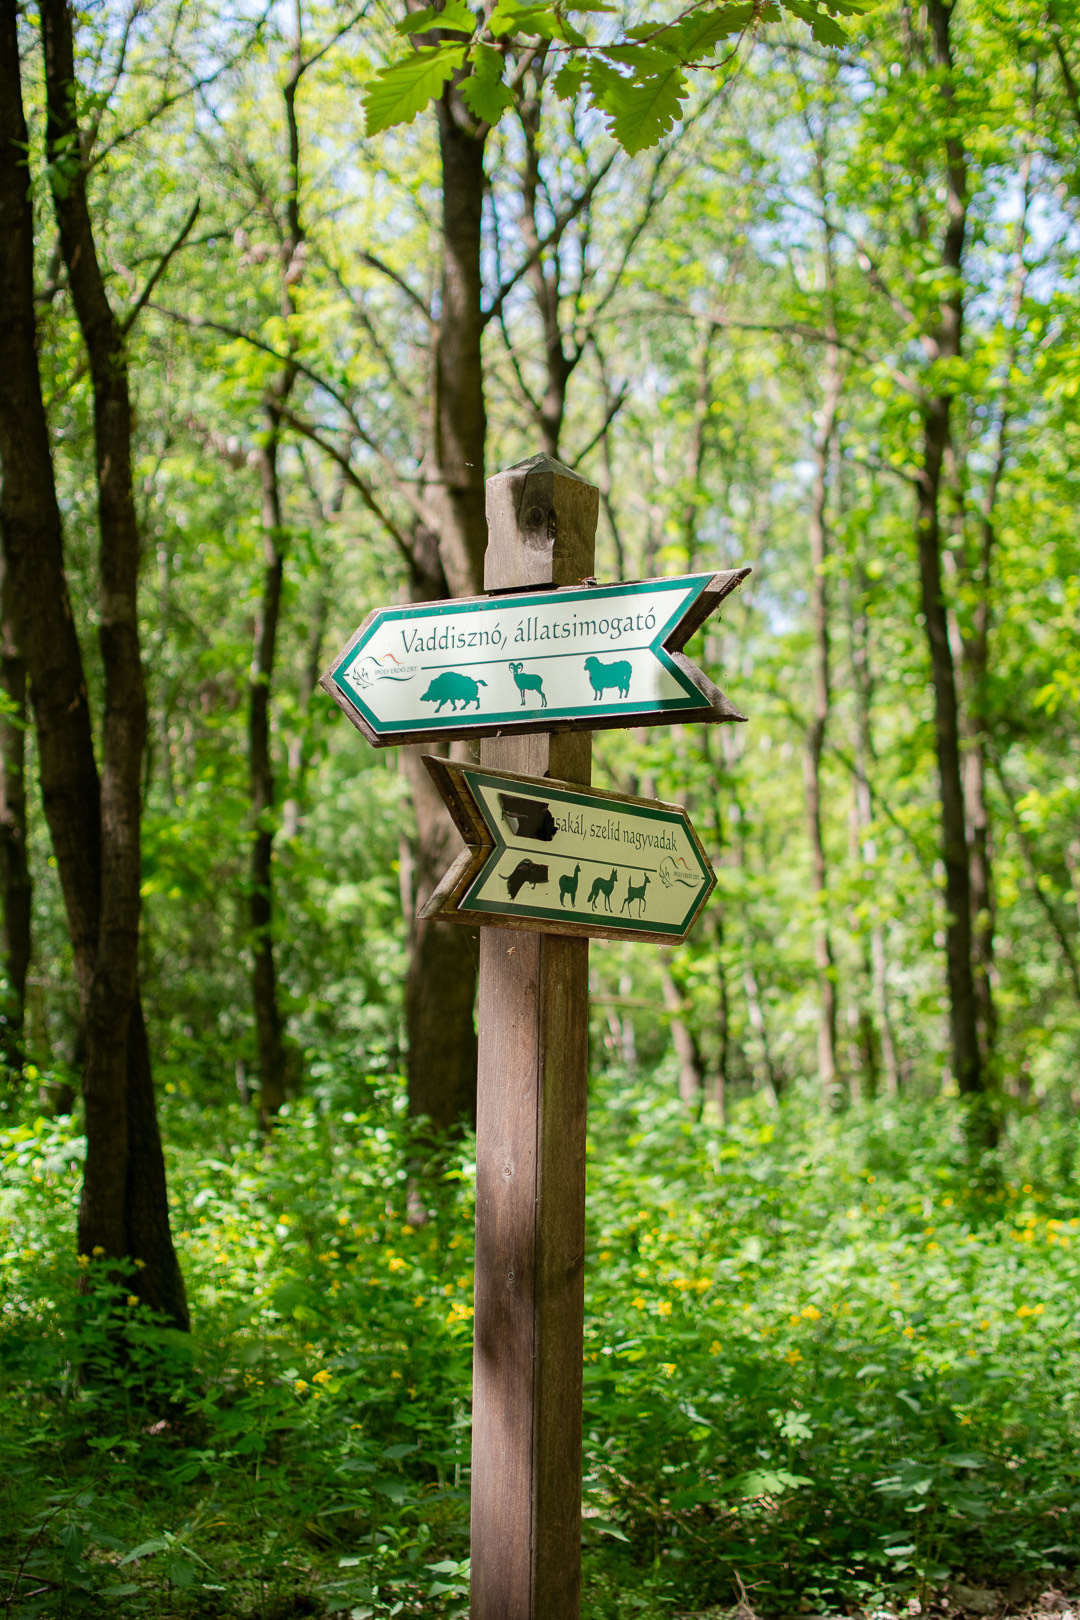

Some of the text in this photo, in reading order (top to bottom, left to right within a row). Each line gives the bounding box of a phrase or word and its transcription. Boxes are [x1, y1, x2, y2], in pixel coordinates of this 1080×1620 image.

[400, 607, 656, 654] Vaddisznó, állatsimogató
[590, 819, 620, 842] szelíd
[623, 830, 678, 851] nagyvadak
